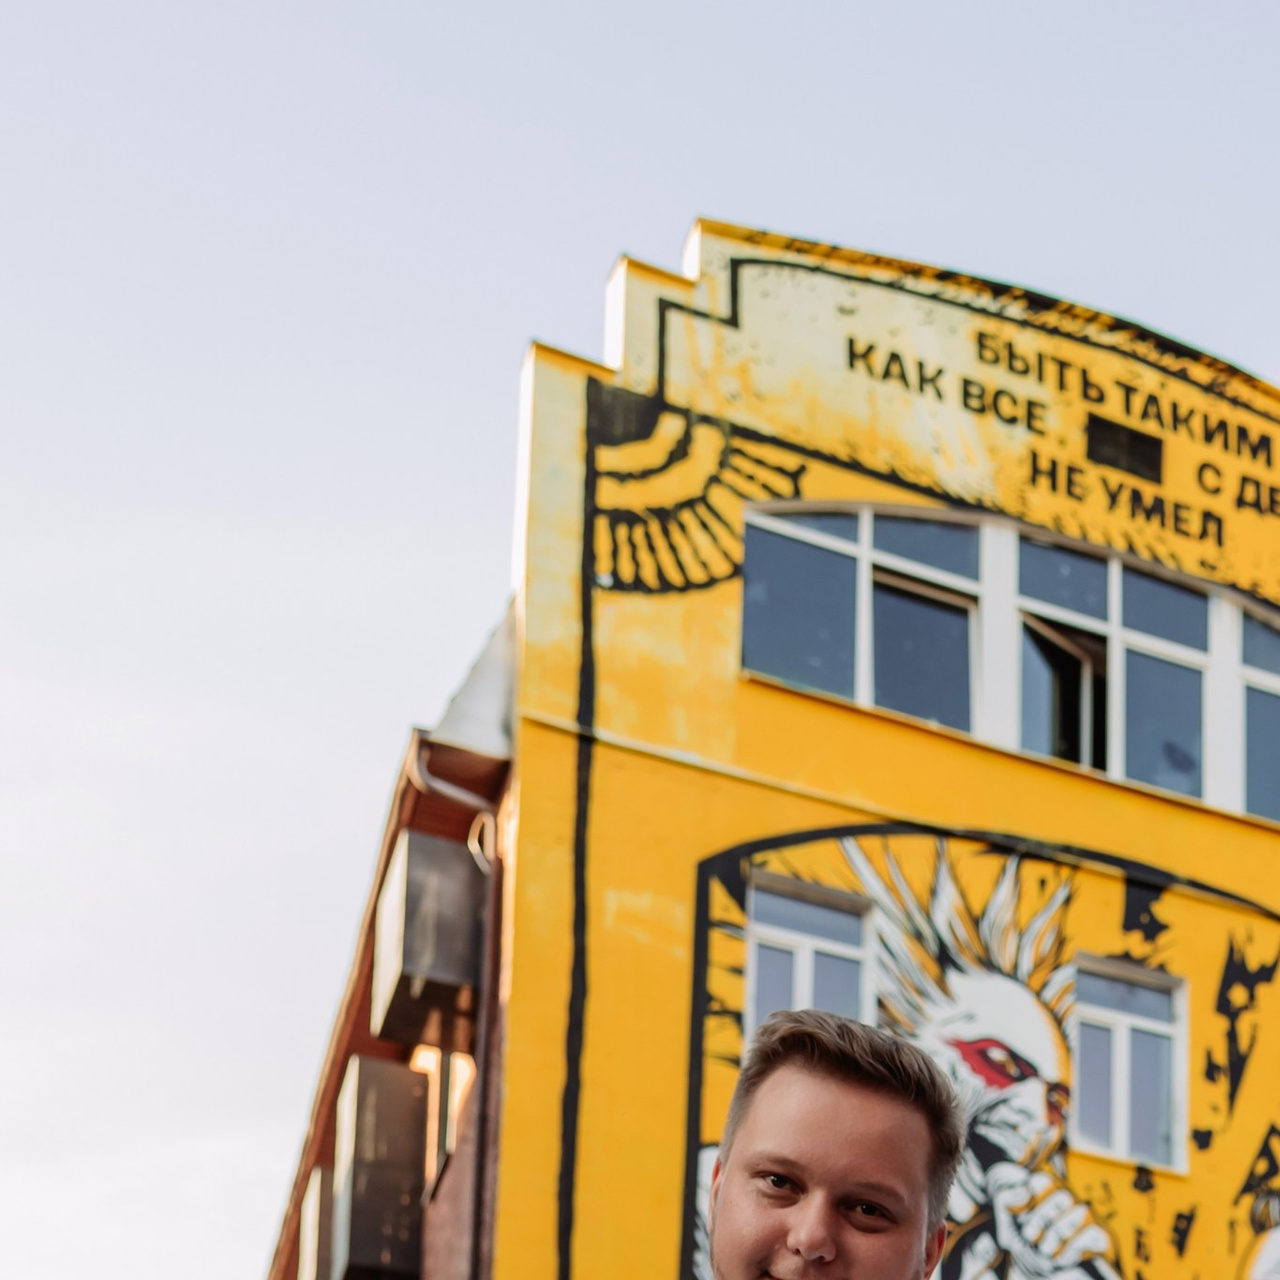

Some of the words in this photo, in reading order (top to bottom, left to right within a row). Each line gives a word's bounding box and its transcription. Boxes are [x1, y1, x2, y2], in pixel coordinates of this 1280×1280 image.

[847, 336, 944, 401] КАК
[961, 376, 1048, 436] ВСЕ
[975, 331, 1105, 403] БЫТЬ
[1115, 379, 1273, 469] ТАКИМ
[1029, 450, 1083, 500] НЕ
[1100, 475, 1224, 548] УМЕЛ
[1196, 461, 1222, 496] С
